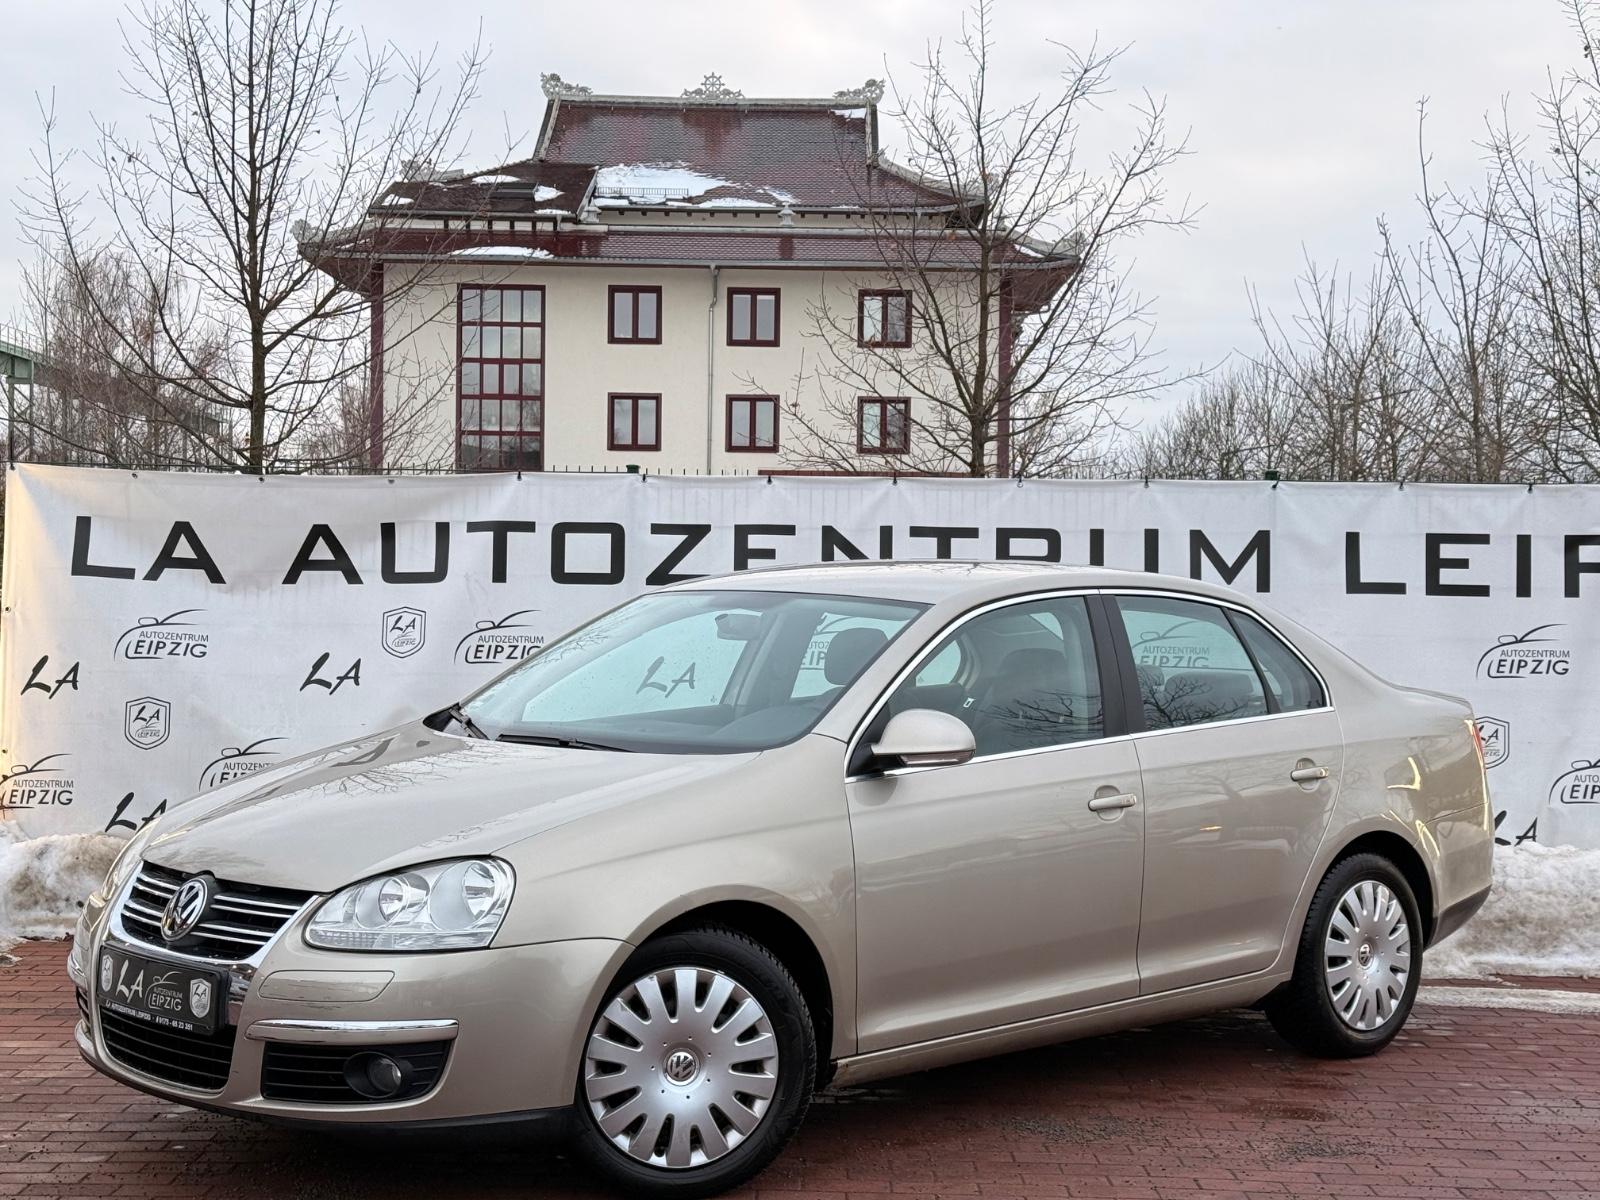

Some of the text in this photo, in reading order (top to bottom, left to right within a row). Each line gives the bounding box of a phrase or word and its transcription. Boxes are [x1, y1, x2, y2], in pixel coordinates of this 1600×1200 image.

[71, 516, 226, 585] LA
[390, 615, 416, 633] LA
[139, 631, 208, 642] AUTOZENTRUM
[478, 635, 544, 644] AUTOZENTRUM
[125, 640, 208, 659] LEIPZIG
[1143, 646, 1210, 655] AUTOZENTRUM
[1500, 650, 1570, 658] AUTOZENTRUM
[1140, 656, 1209, 667] EIPZIG
[1487, 659, 1570, 678] LEIPZIG
[21, 655, 79, 699] LA
[300, 652, 361, 695] LA
[636, 656, 696, 698] LA
[132, 705, 160, 724] LA
[13, 780, 73, 789] AUTOZENTRUM
[115, 960, 144, 1003] LA
